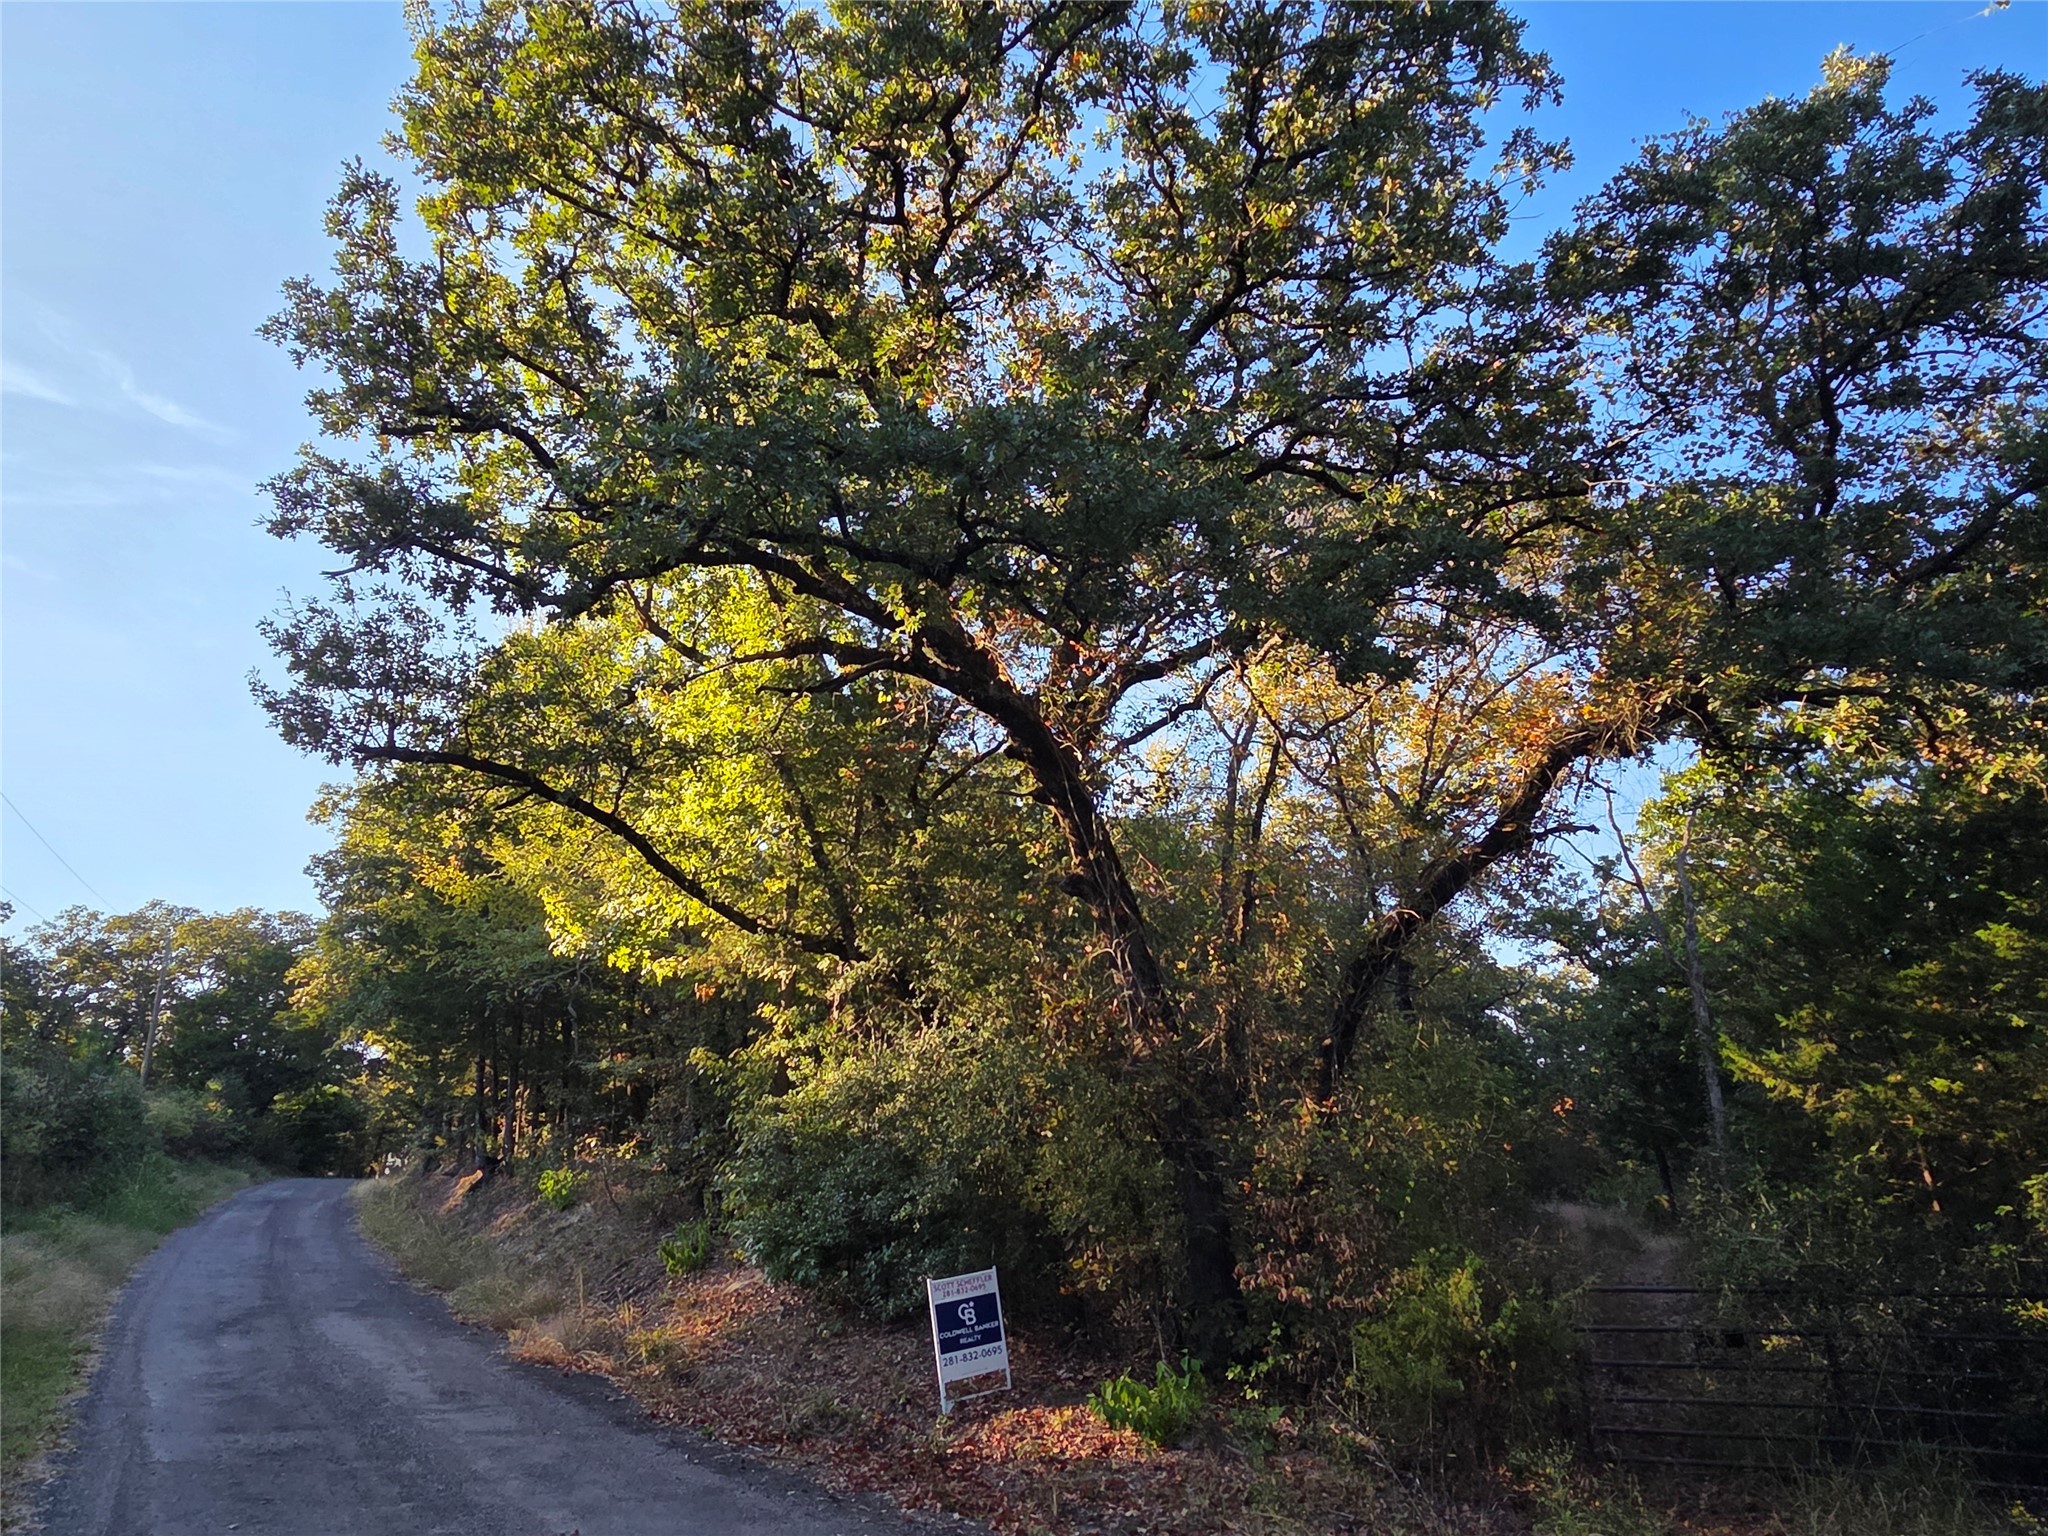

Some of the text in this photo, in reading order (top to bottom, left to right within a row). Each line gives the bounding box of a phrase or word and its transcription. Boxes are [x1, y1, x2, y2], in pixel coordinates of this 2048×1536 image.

[933, 1274, 992, 1292] SCOTT SCHEFFLER
[939, 1320, 999, 1339] COLDWELL BANKER
[960, 1334, 981, 1344] REALTY
[943, 1345, 1003, 1367] 281-832-0695
